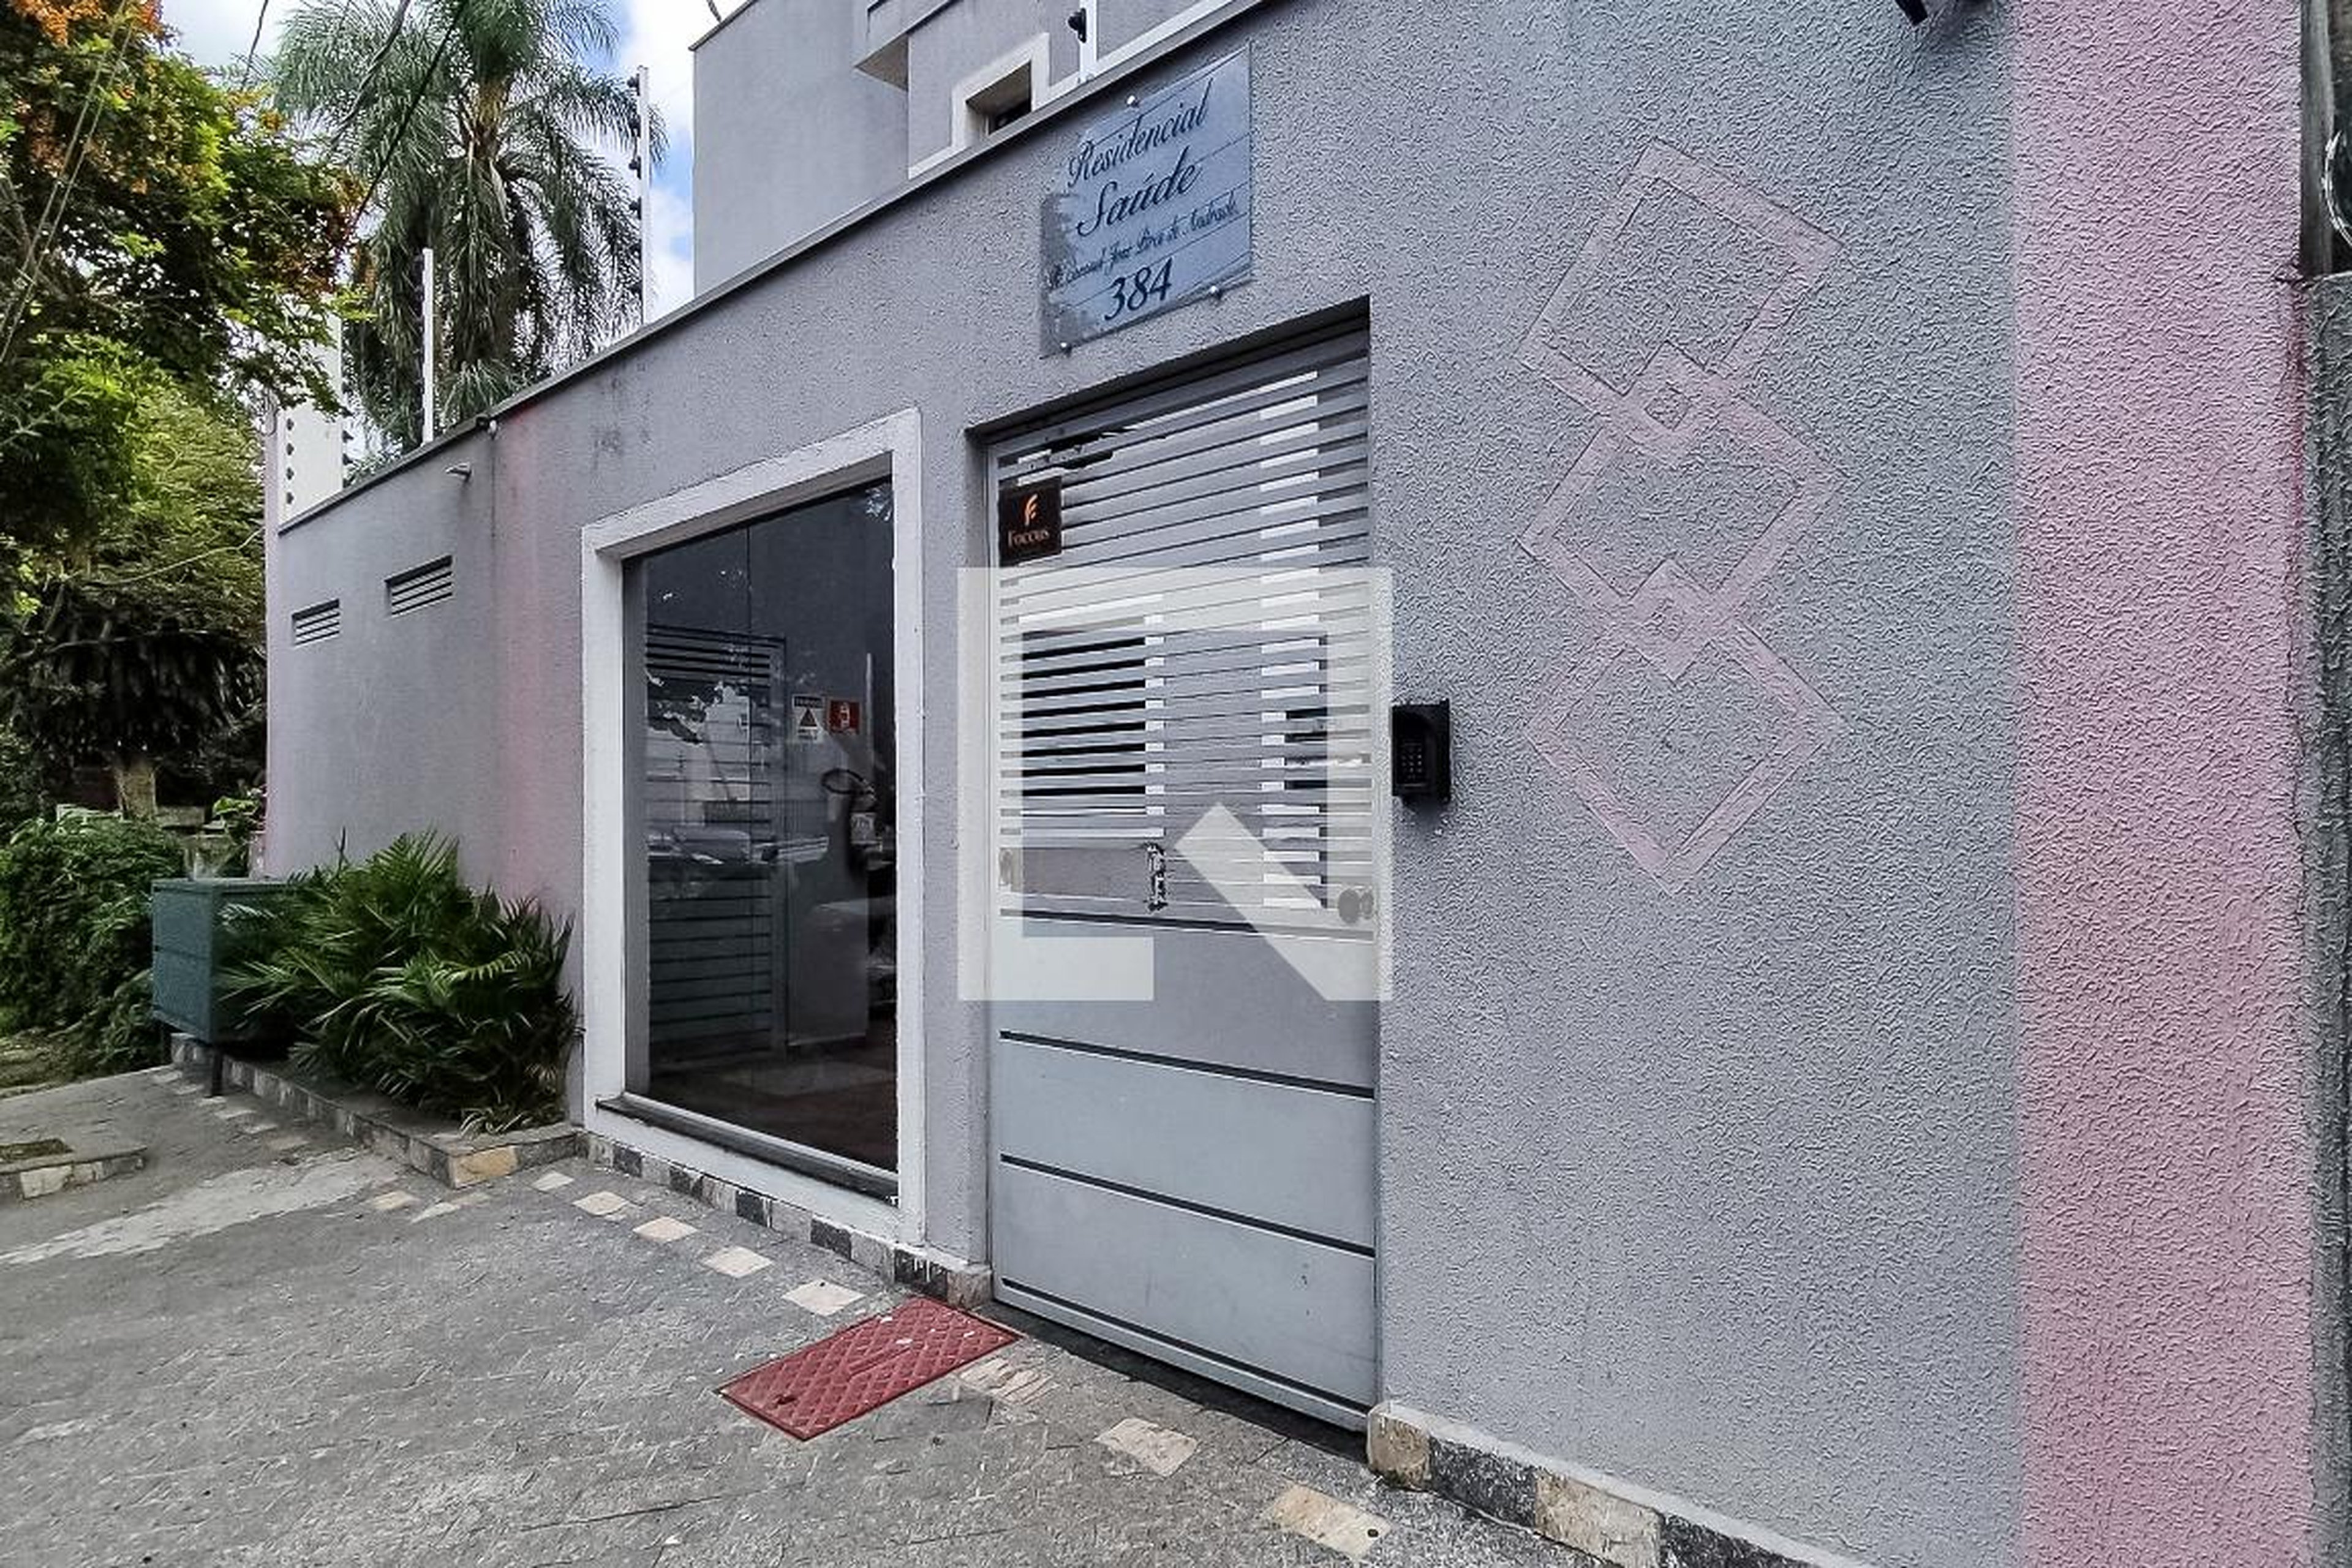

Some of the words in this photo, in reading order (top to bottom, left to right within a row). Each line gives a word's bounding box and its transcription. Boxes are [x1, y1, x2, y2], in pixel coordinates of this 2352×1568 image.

[1068, 77, 1213, 188] Residencial
[1076, 145, 1201, 238] Saúde
[1104, 257, 1173, 321] 384
